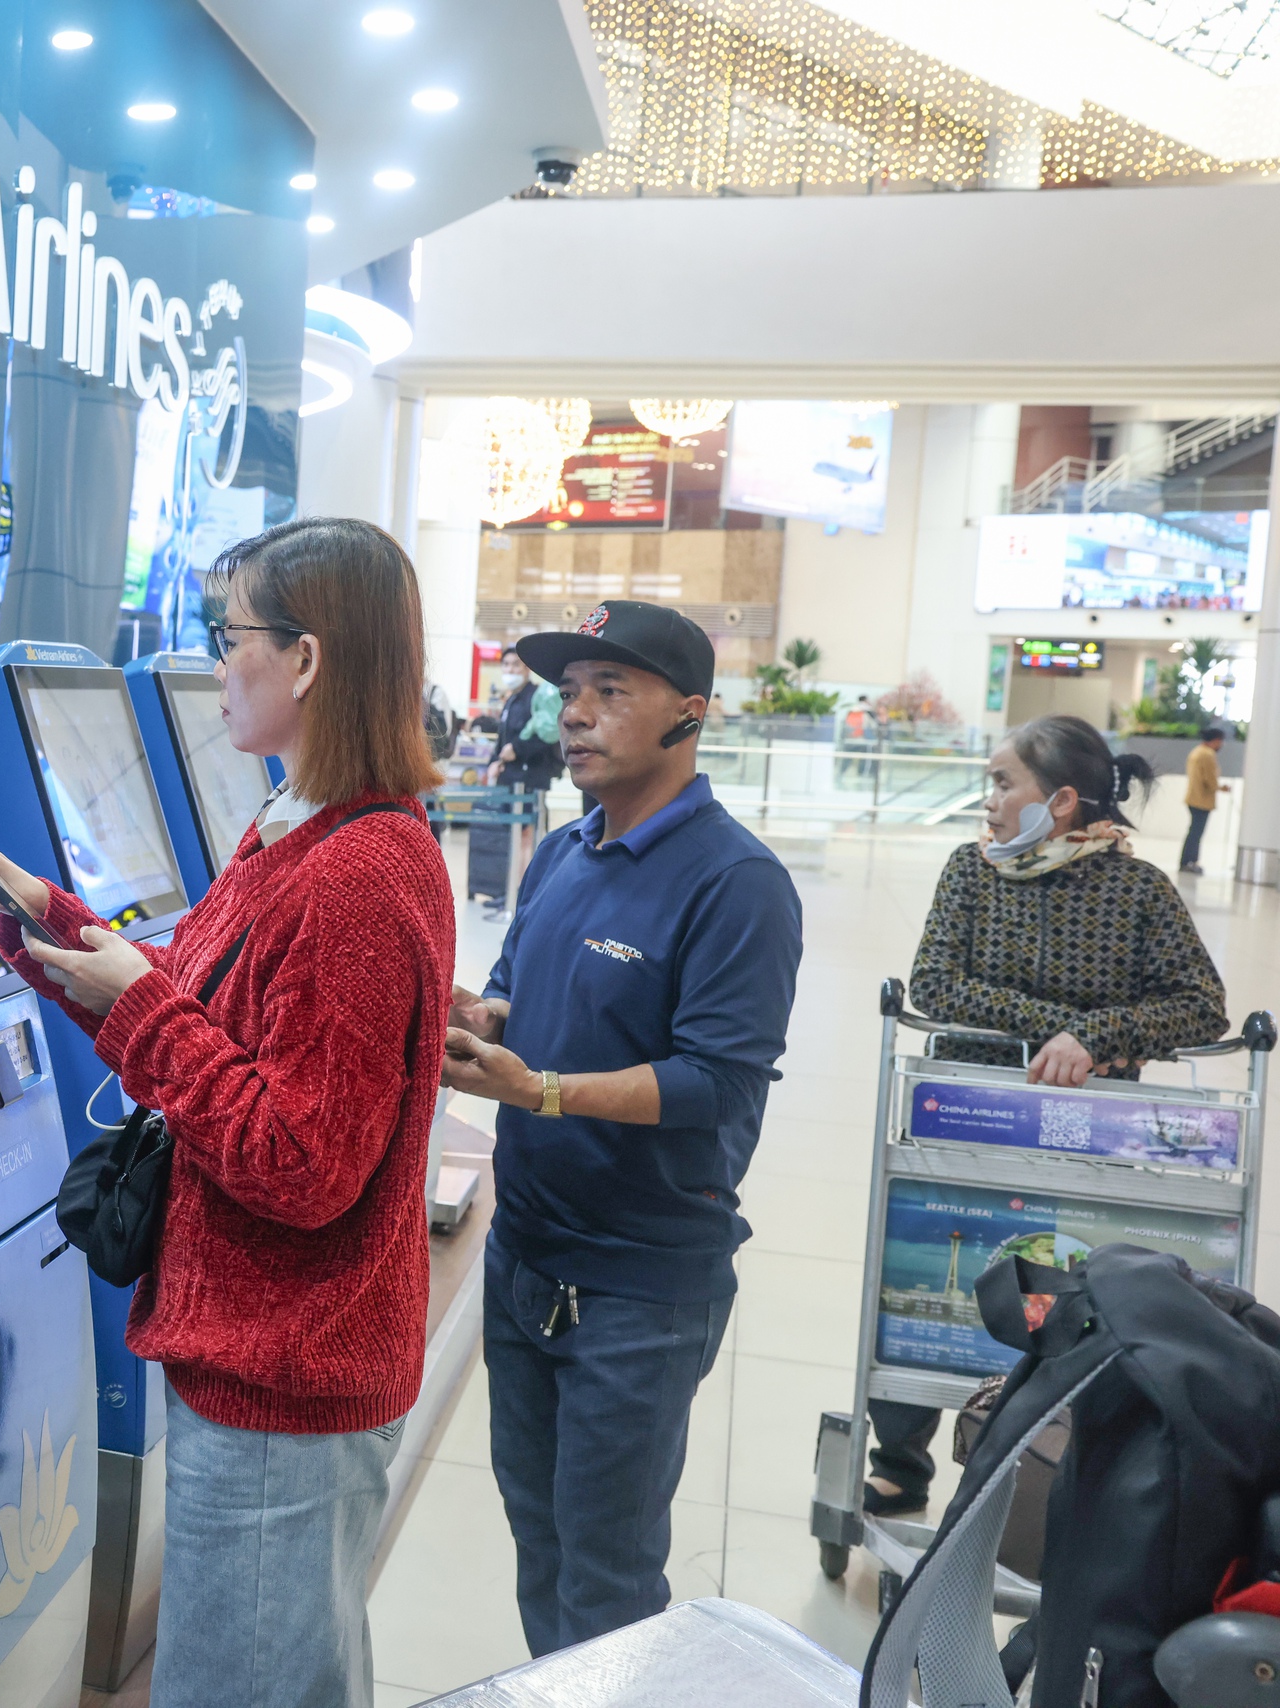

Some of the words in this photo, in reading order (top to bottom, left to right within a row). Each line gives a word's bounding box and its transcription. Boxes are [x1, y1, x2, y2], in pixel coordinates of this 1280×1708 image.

[939, 1105, 970, 1116] CHINA
[972, 1108, 1015, 1119] AIRLINES
[926, 1202, 965, 1214] SEATTLE
[967, 1208, 993, 1219] (SEA)
[1024, 1205, 1053, 1214] CHINA
[1124, 1226, 1169, 1239] PHOENIX
[1172, 1231, 1202, 1244] (PHX)
